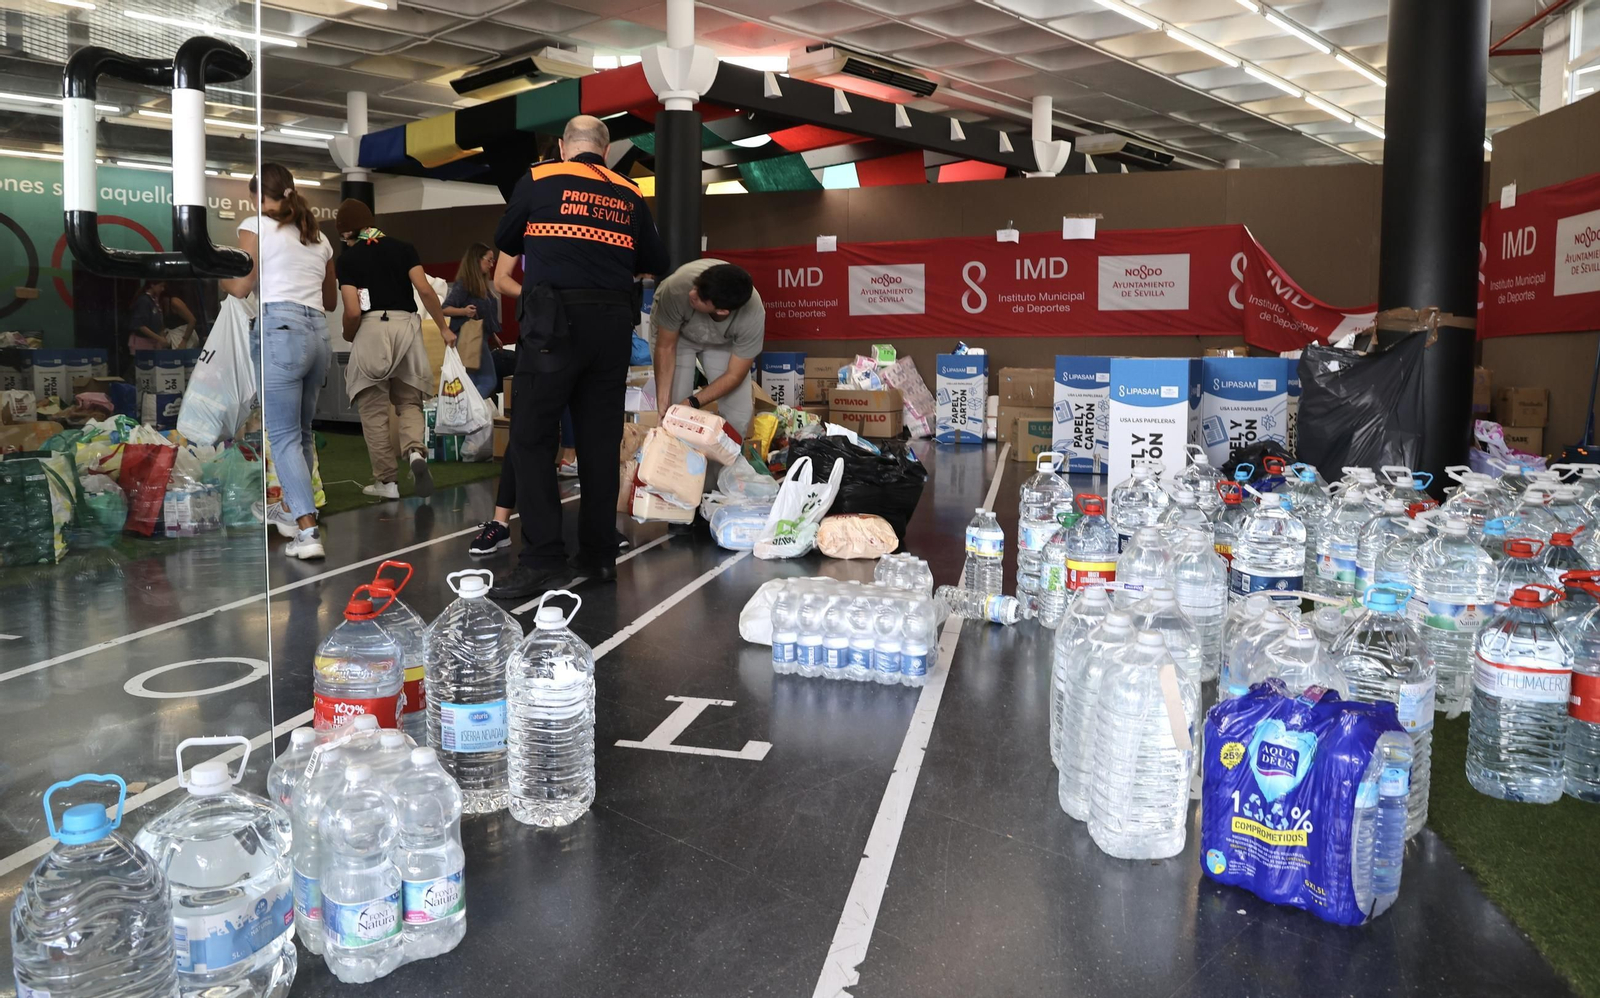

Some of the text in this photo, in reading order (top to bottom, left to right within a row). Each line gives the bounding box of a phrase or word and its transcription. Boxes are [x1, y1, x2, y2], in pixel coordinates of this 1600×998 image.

[208, 197, 232, 209] ue
[560, 203, 631, 225] CIVIL SEVILLA
[1501, 225, 1537, 260] IMD
[1016, 257, 1068, 280] IMD
[777, 267, 823, 288] IMD
[1490, 271, 1547, 291] Instituto Municipal
[763, 298, 839, 309] Instituto Municipal
[998, 291, 1085, 303] Instituto Municipal
[1248, 294, 1285, 314] Instituto
[1497, 289, 1536, 305] de Deportes
[775, 309, 827, 319] de Deportes
[1012, 303, 1071, 315] de Deportes
[1259, 311, 1271, 321] de
[1126, 387, 1159, 395] LIPASAM
[843, 413, 886, 422] POLVILLO
[1073, 403, 1084, 448] PAPEL Y
[1083, 403, 1095, 450] CARTÓN
[1223, 751, 1243, 760] 25%
[1262, 745, 1296, 762] AQUA
[1262, 754, 1294, 770] DEUS
[1234, 820, 1304, 843] COMPROMETIDOS
[424, 891, 459, 909] Natura
[434, 887, 453, 899] FONT
[357, 913, 395, 932] Natura
[369, 910, 388, 922] FONT
